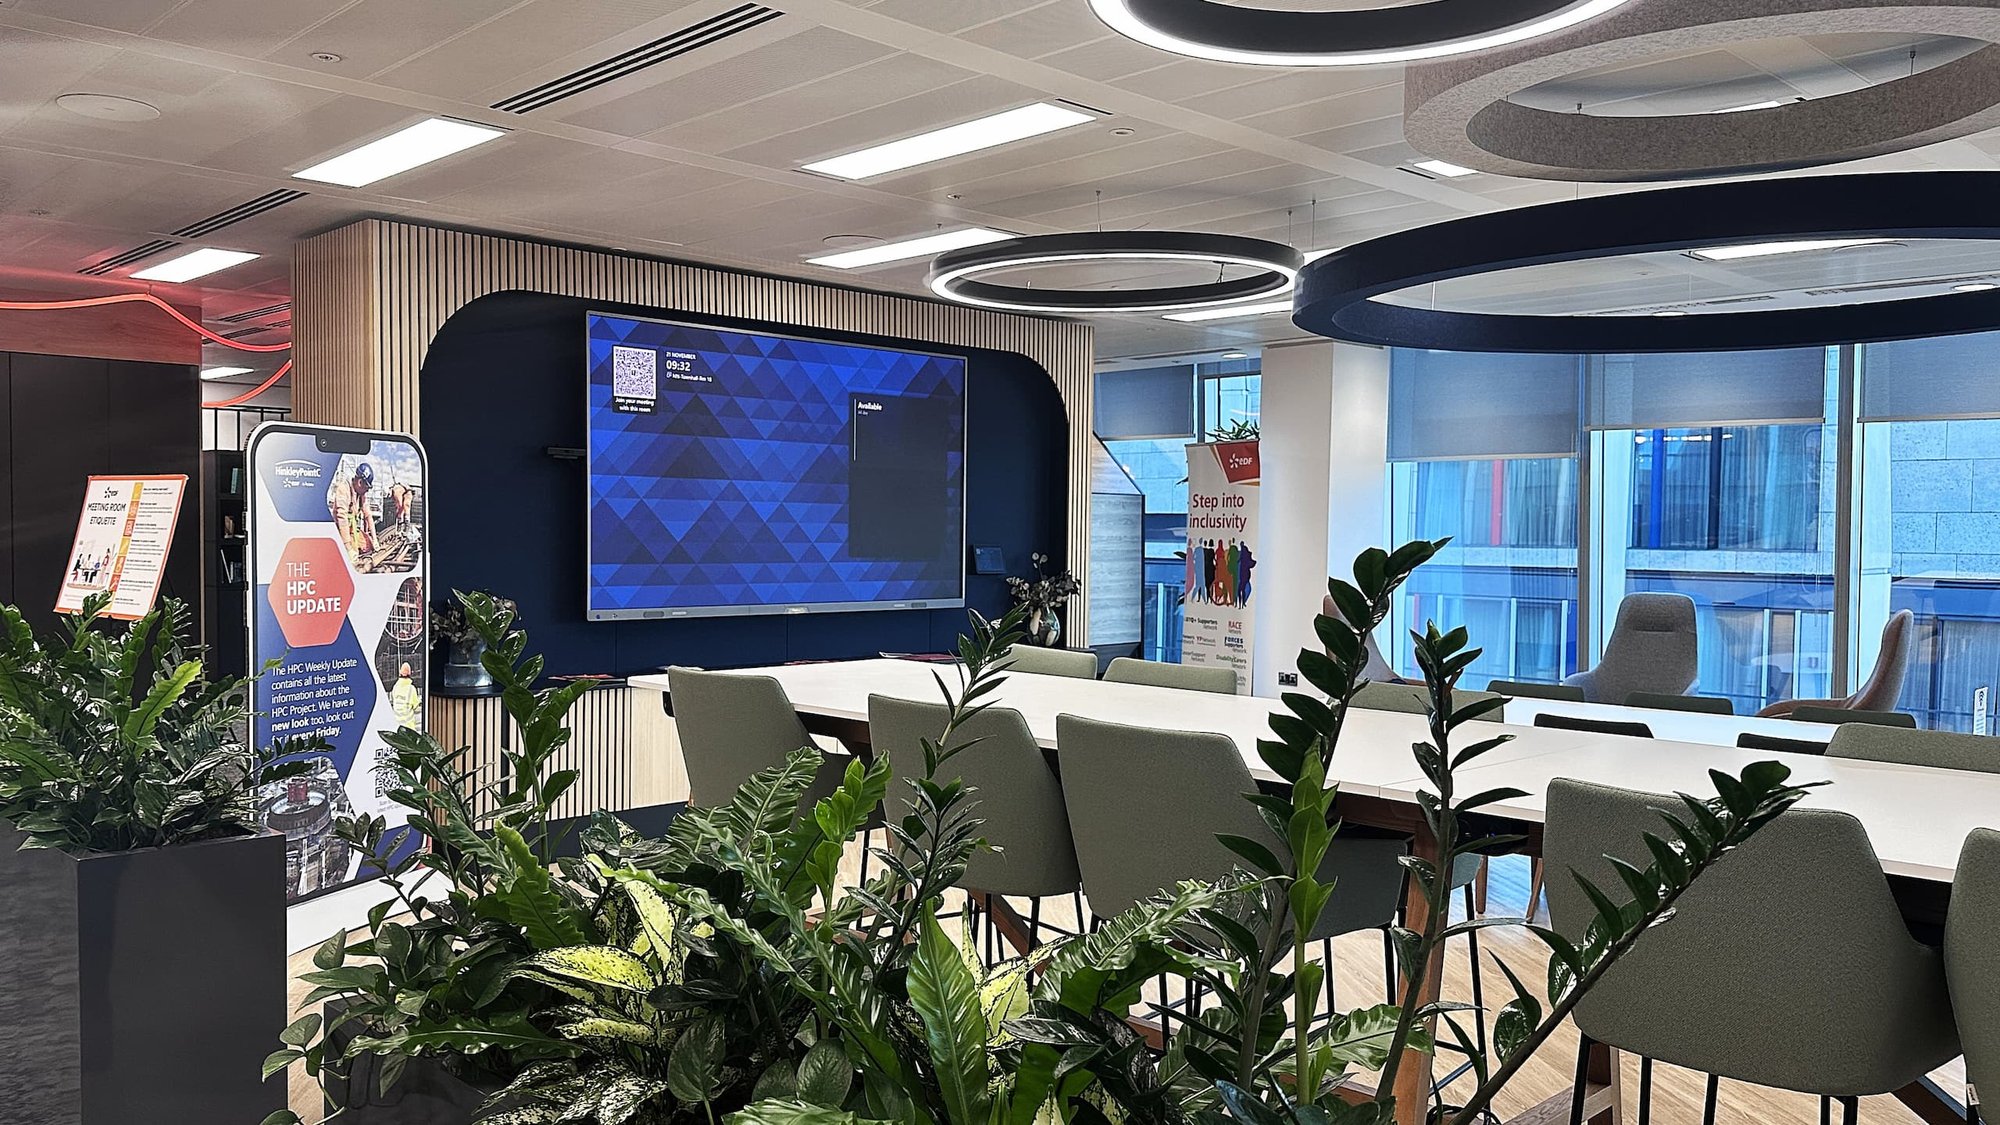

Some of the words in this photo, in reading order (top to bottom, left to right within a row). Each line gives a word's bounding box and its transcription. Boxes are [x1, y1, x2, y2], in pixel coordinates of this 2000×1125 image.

[666, 360, 690, 371] 09:32
[858, 401, 882, 410] Available
[87, 503, 109, 511] MEETING
[110, 503, 126, 511] ROOM
[1192, 494, 1218, 512] Step
[1222, 492, 1244, 508] into
[90, 516, 117, 525] ETIQUETTE
[1189, 513, 1247, 532] inclusivity
[286, 562, 310, 578] THE
[286, 580, 316, 596] HPC
[286, 597, 341, 614] UPDATE
[1228, 620, 1242, 630] RACE
[272, 666, 286, 676] The
[287, 663, 304, 675] HPC
[305, 660, 331, 672] Weekly
[332, 658, 357, 670] Update
[271, 678, 303, 690] contains
[304, 676, 312, 687] all
[314, 675, 326, 685] the
[327, 672, 347, 683] latest
[271, 690, 314, 704] information
[315, 687, 336, 698] about
[338, 685, 350, 694] the
[271, 706, 288, 718] HPC
[289, 703, 317, 716] Project.
[318, 701, 331, 711] We
[332, 699, 349, 708] have
[271, 722, 290, 732] new
[291, 717, 309, 729] look
[310, 716, 325, 725] too,
[326, 712, 341, 722] look
[341, 711, 354, 720] out
[316, 726, 341, 737] Friday.
